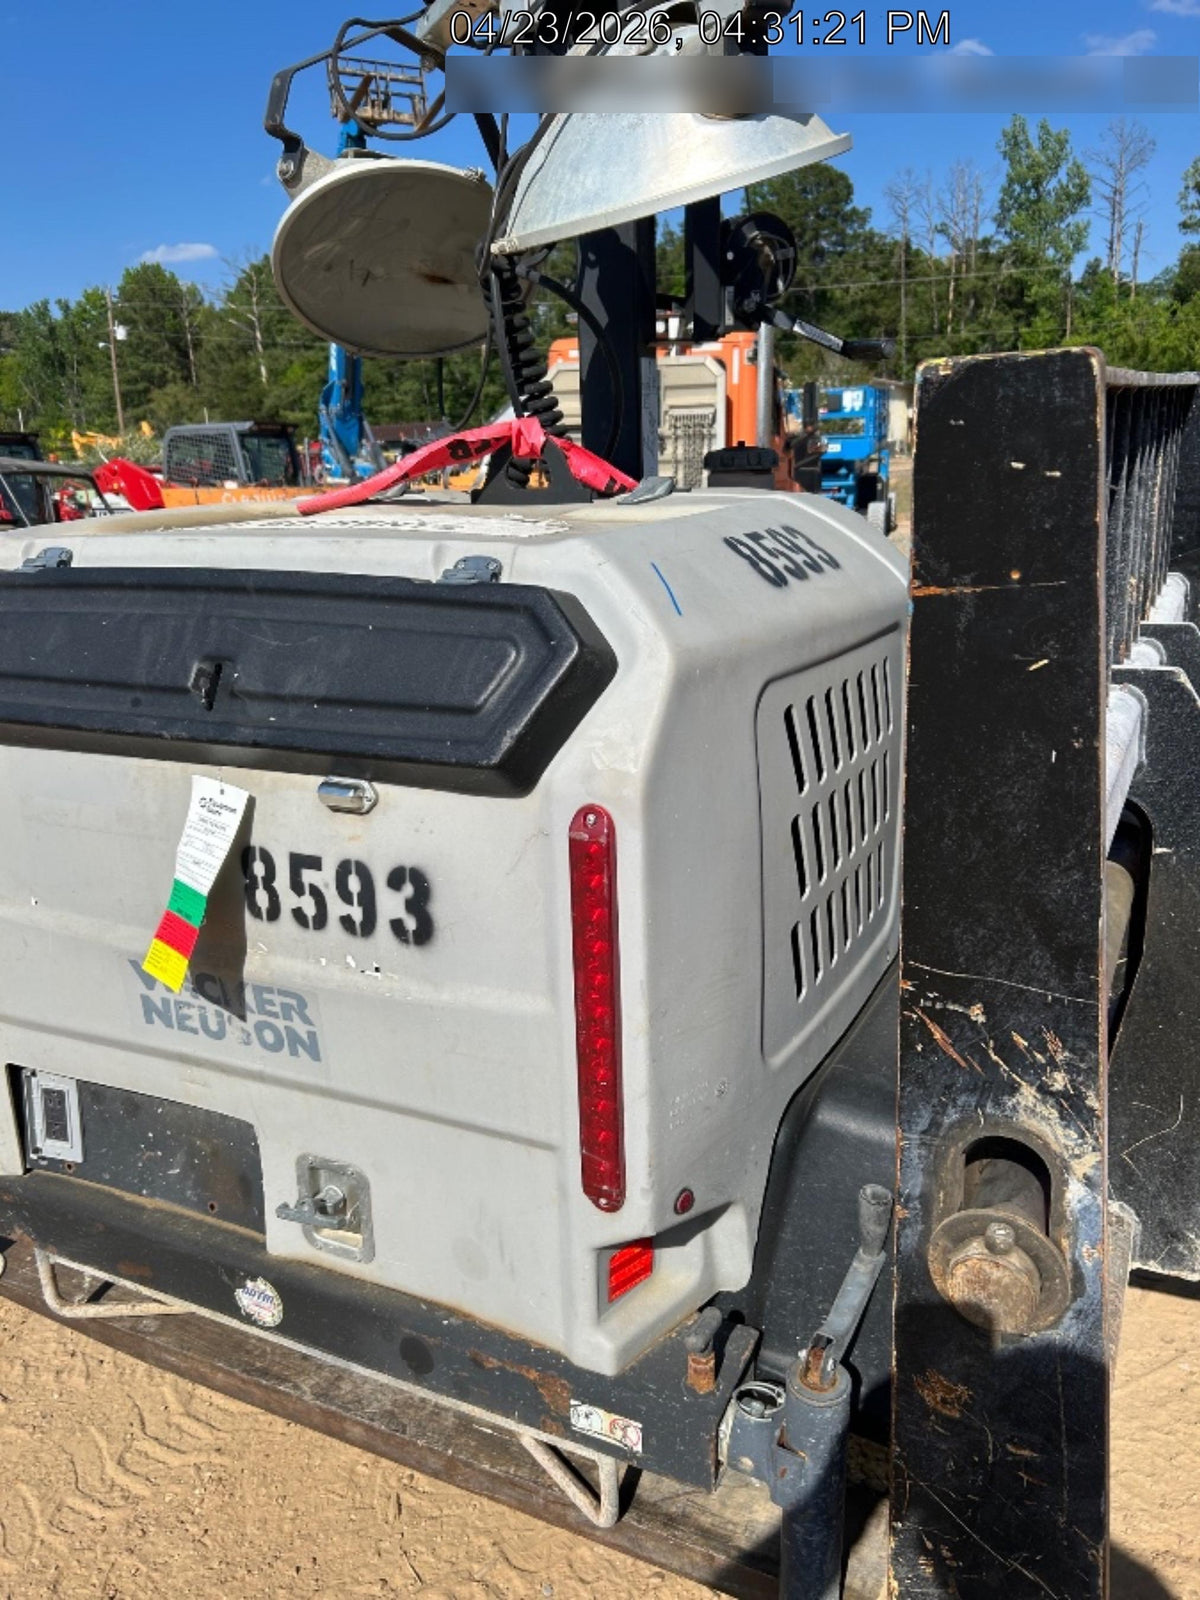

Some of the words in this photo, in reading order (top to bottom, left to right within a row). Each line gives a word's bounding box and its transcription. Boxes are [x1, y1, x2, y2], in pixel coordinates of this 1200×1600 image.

[723, 525, 840, 588] 8593
[241, 845, 434, 947] 8593
[140, 993, 322, 1063] NEUON
